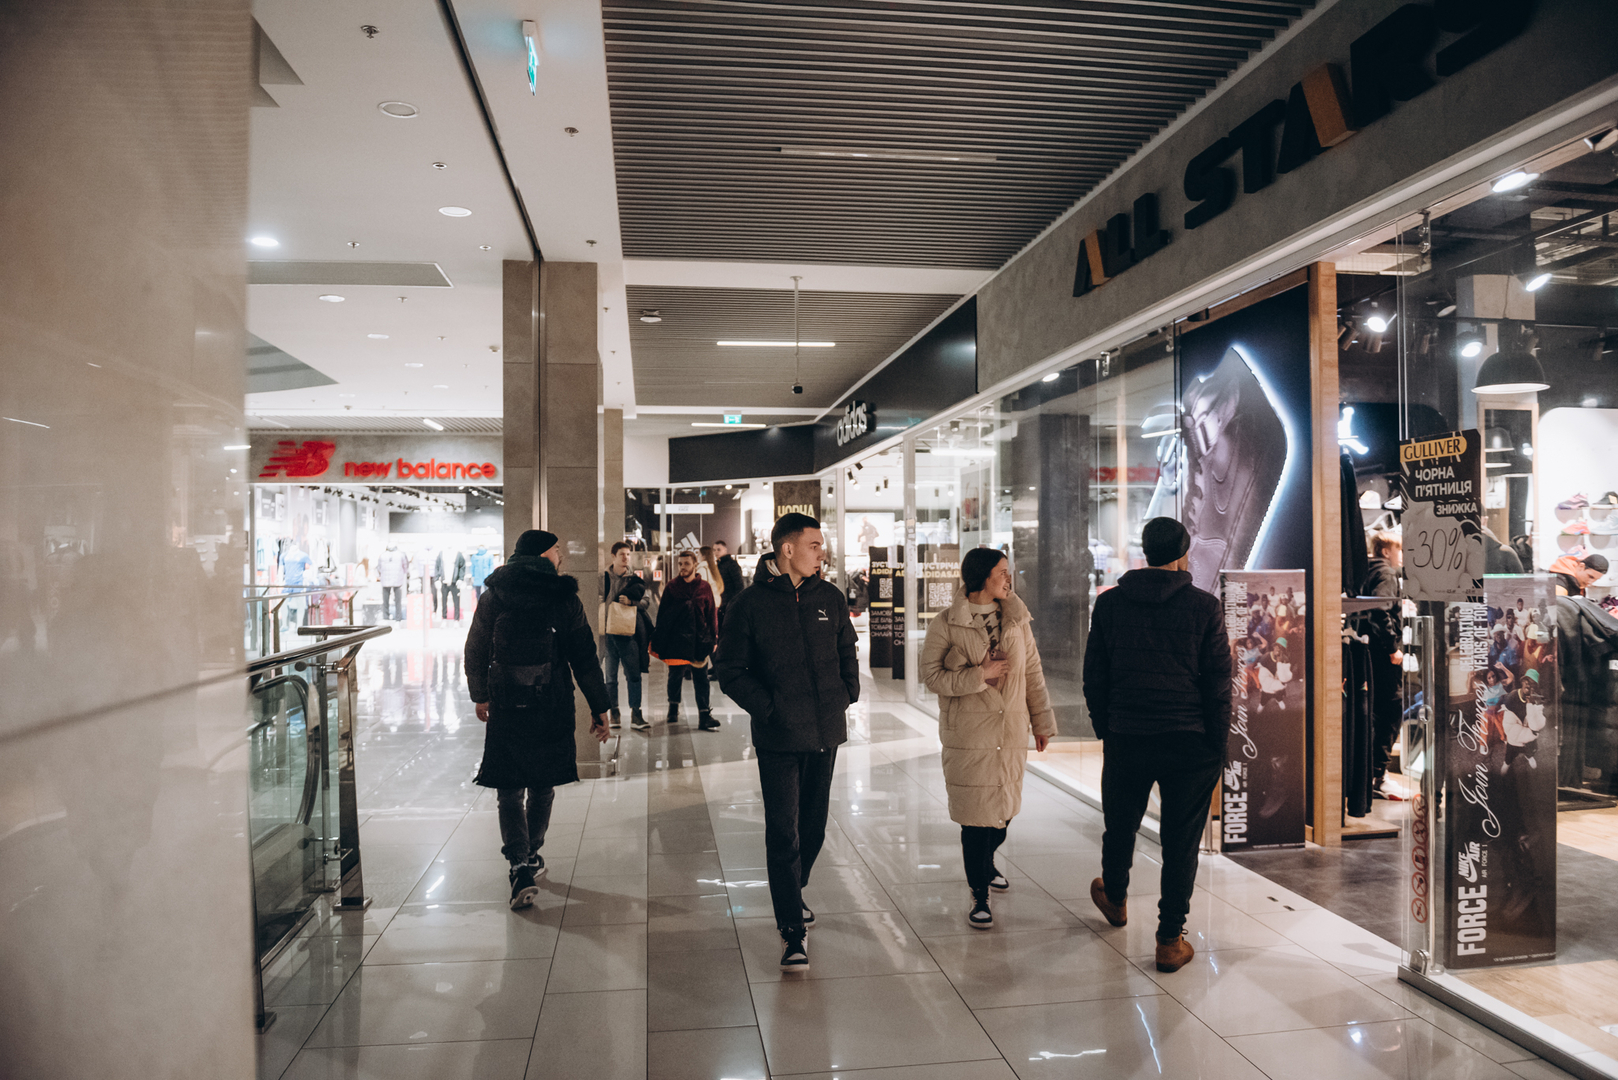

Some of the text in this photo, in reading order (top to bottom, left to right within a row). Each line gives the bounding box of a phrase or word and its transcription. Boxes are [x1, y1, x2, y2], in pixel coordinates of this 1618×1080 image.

[1073, 0, 1538, 297] ALL STARS
[837, 400, 867, 446] adidas
[1403, 438, 1461, 460] GULLIVER
[344, 458, 496, 478] new balance
[1415, 466, 1454, 482] ЧОРНА
[1415, 480, 1472, 497] П'ЯТНИЦЯ
[1436, 502, 1478, 515] ЗНИЖКА
[1408, 528, 1463, 571] -30%
[919, 562, 960, 570] УСТРІЧА
[1236, 582, 1248, 639] YEARS OF FORCE
[1459, 608, 1474, 672] CELEBRATING
[1474, 625, 1488, 637] OF
[1474, 641, 1488, 671] YEARS
[1230, 704, 1257, 759] Join
[1457, 681, 1500, 838] Join Forces
[1224, 792, 1248, 843] FORCE
[1458, 852, 1469, 877] NIKE
[1469, 841, 1480, 862] AIR
[1457, 885, 1487, 956] FORCE
